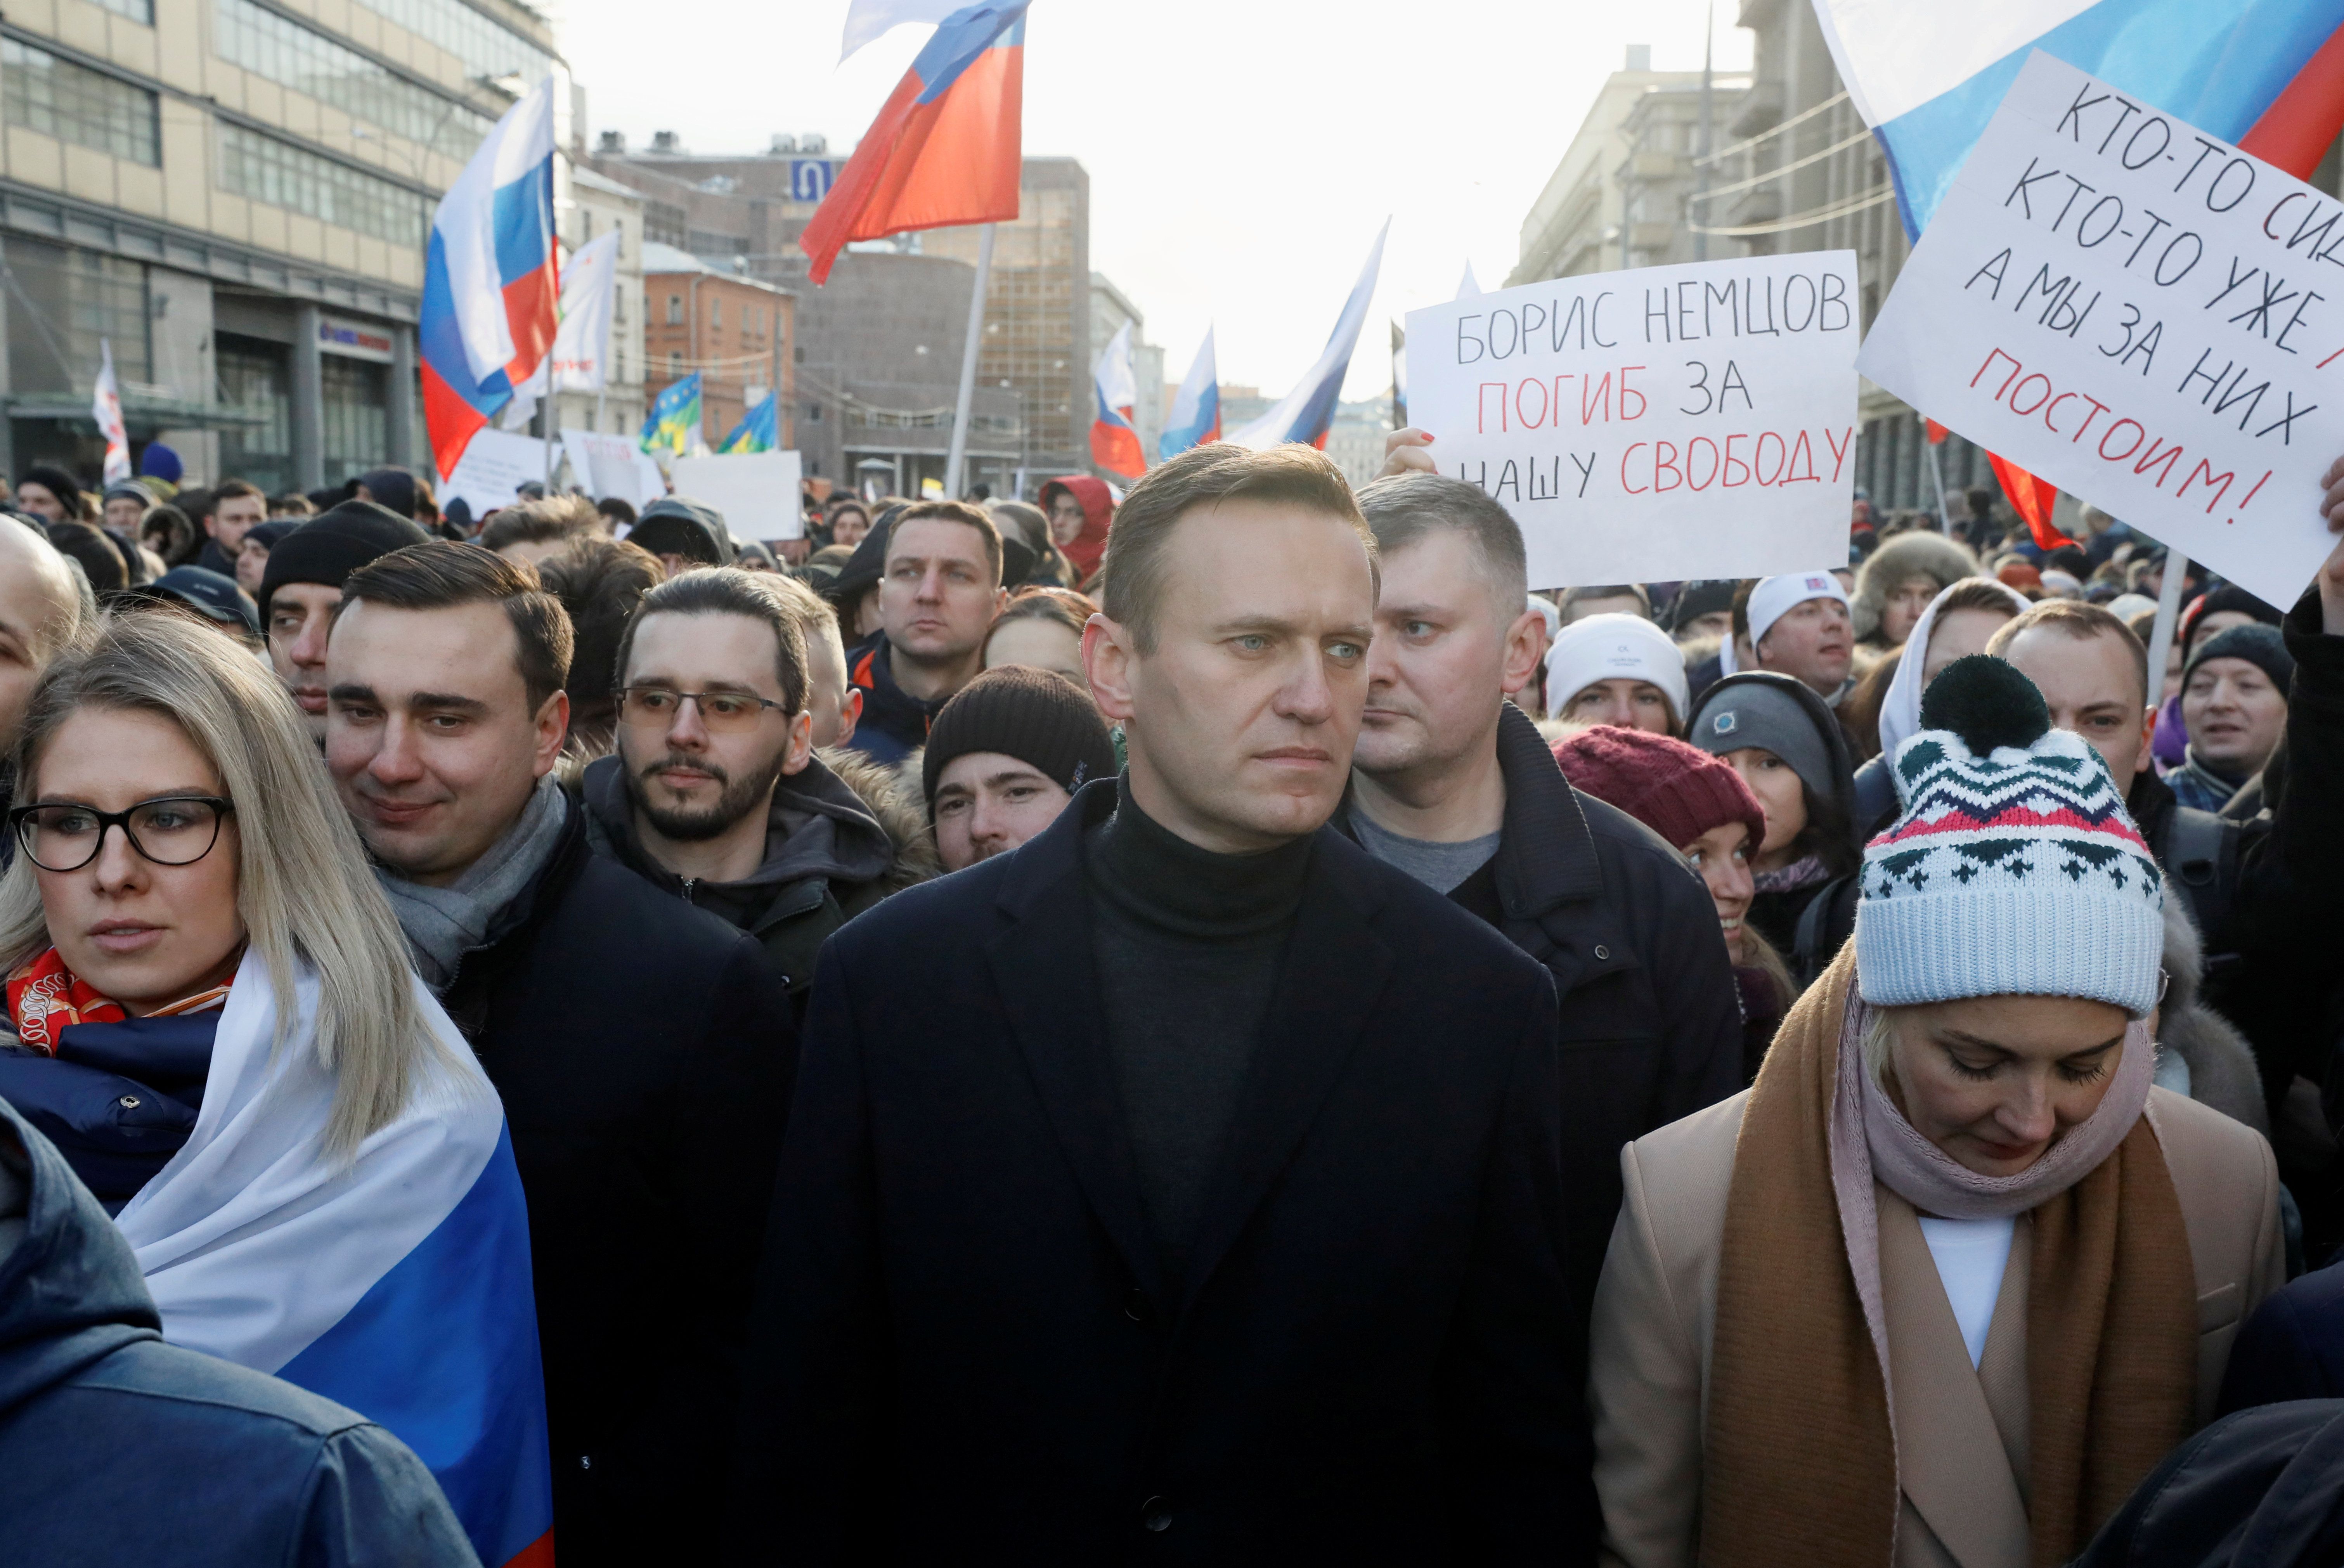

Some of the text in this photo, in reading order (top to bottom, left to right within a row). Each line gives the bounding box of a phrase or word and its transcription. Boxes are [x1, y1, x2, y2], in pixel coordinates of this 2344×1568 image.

[2057, 83, 2255, 212] КТО-ТО
[1458, 274, 1849, 364] БОРИС НЕМЦОВ
[2005, 157, 2325, 354] КТО-ТО УЖЕ
[1479, 360, 1752, 433] ПОГИБ ЗА
[1965, 248, 2318, 445] А МЫ ЗА НИХ
[1622, 427, 1852, 494] СВОБОДУ
[1970, 348, 2272, 524] ПОСТОИМ!
